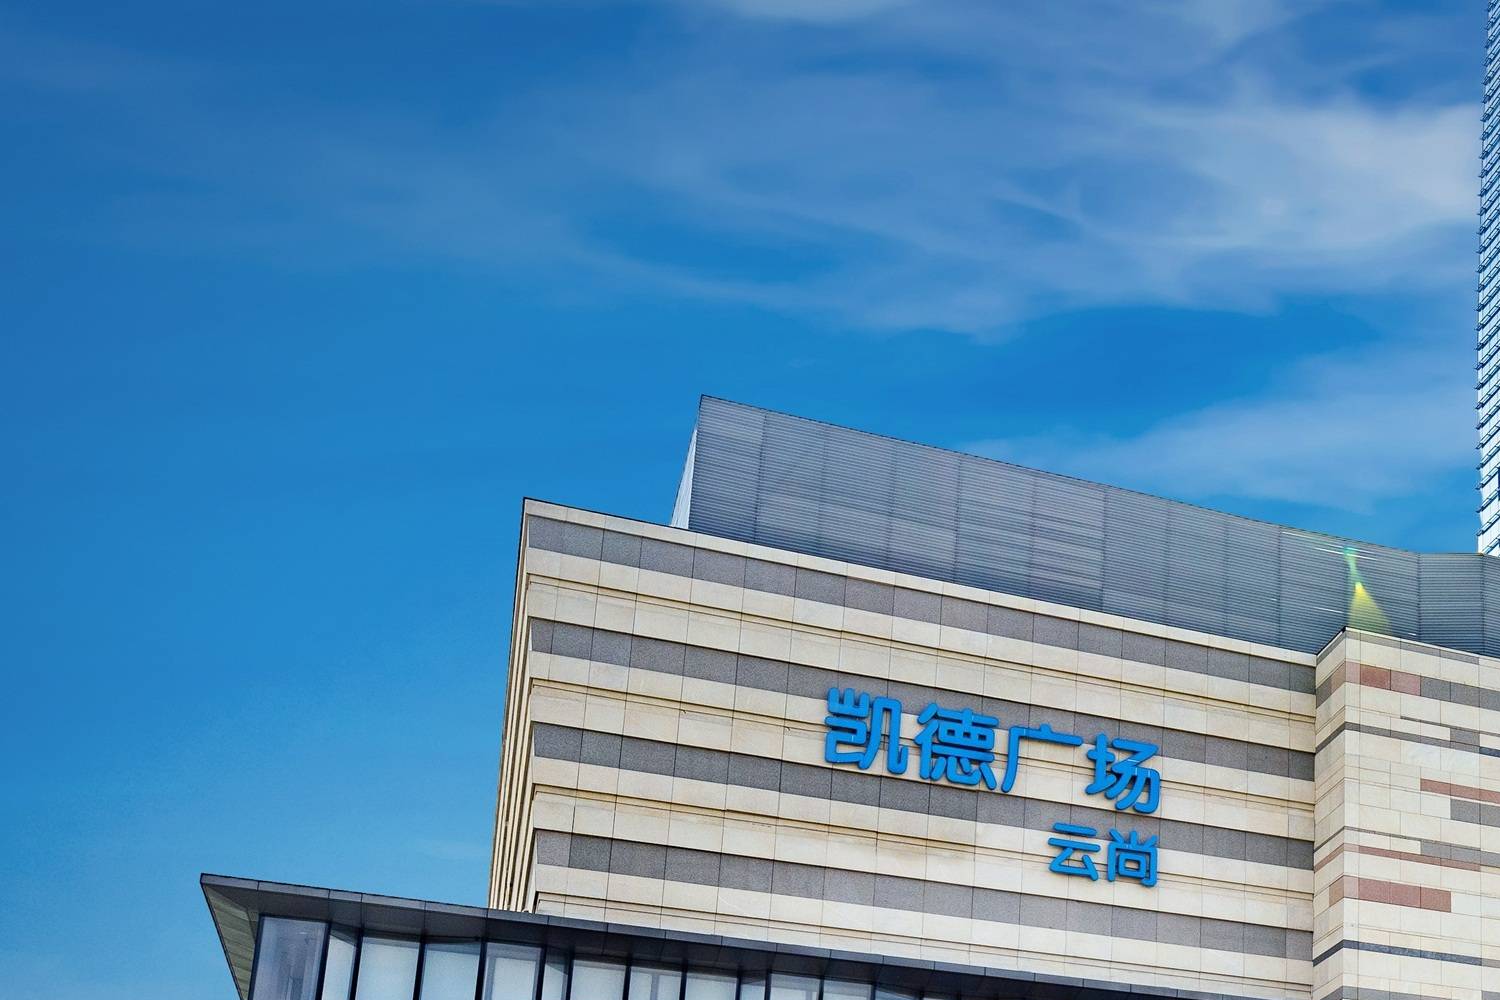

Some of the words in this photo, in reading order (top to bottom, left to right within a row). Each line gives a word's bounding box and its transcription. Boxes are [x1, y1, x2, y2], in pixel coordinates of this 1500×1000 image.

[825, 687, 1161, 814] 凯德广场
[1048, 822, 1159, 887] 云尚
